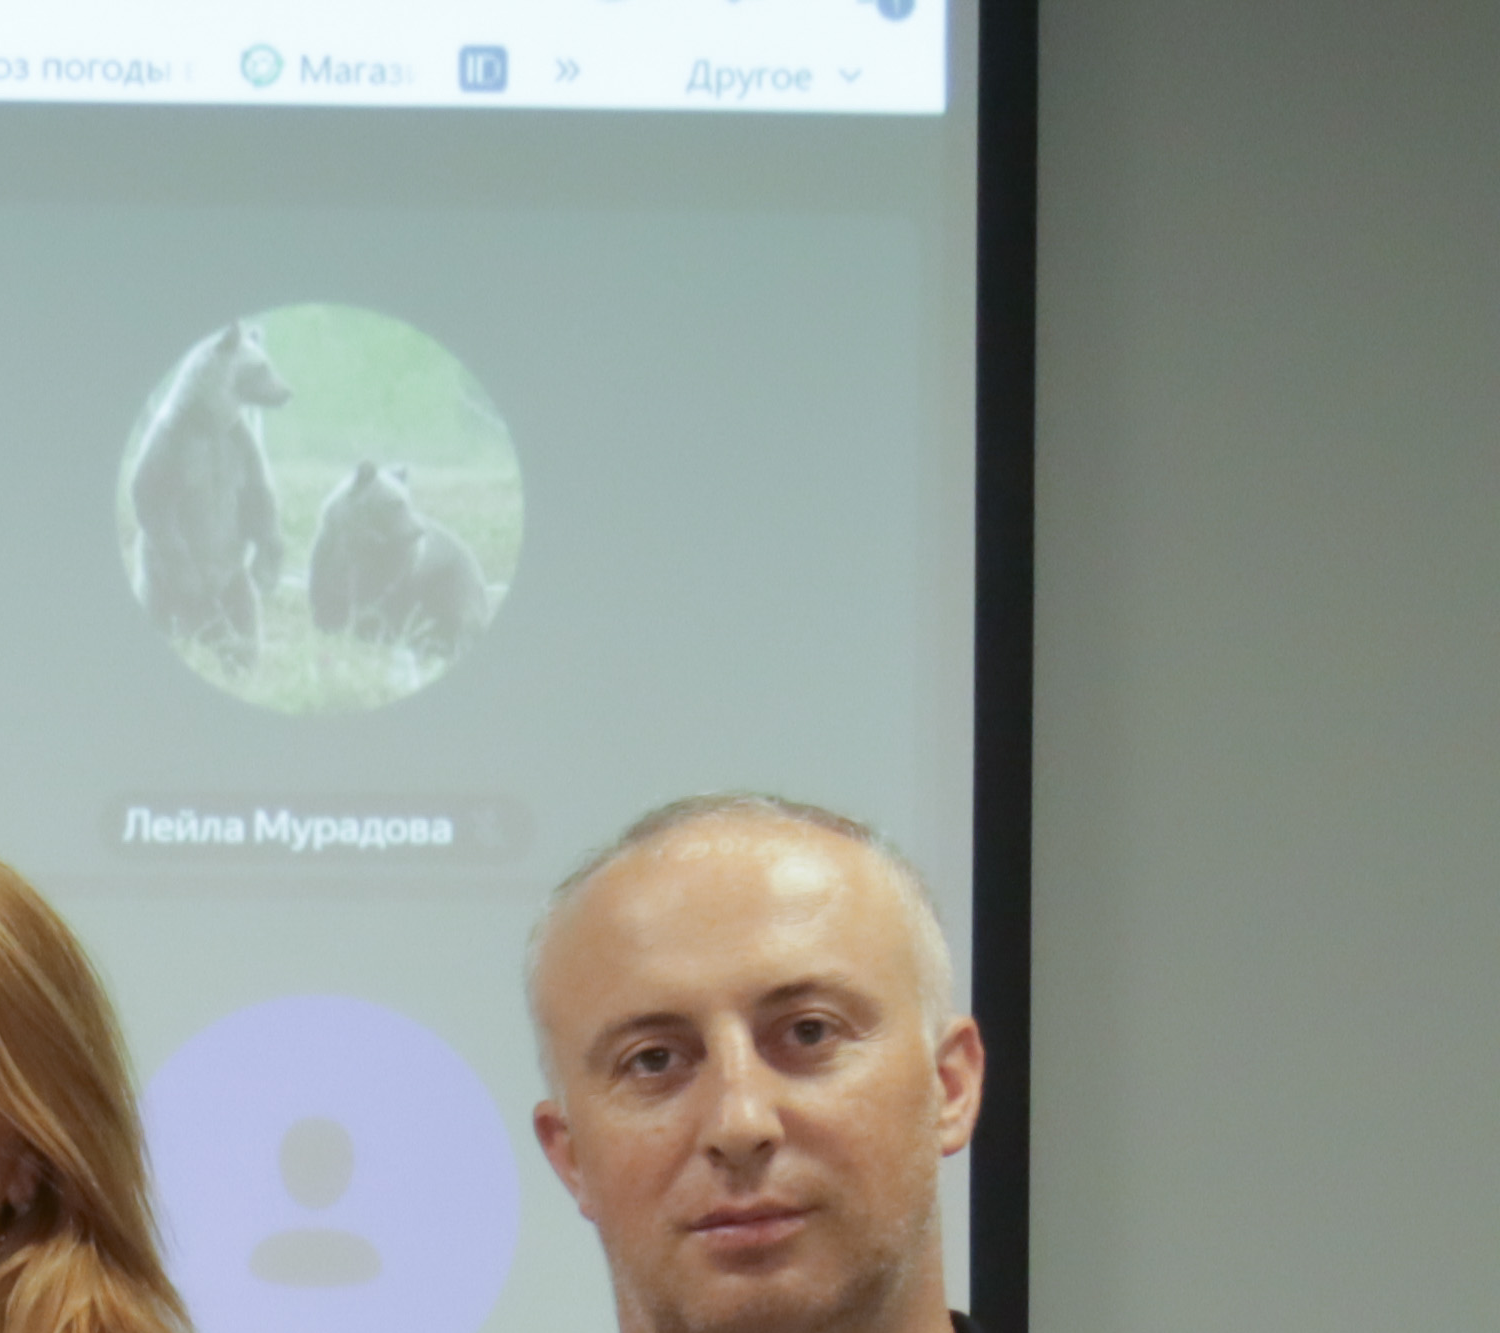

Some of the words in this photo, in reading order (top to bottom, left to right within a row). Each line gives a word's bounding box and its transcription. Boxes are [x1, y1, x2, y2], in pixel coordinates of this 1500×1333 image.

[43, 56, 172, 88] погоды
[685, 58, 813, 99] Другое
[122, 807, 245, 843] Лейла
[253, 808, 454, 851] Мурадова
